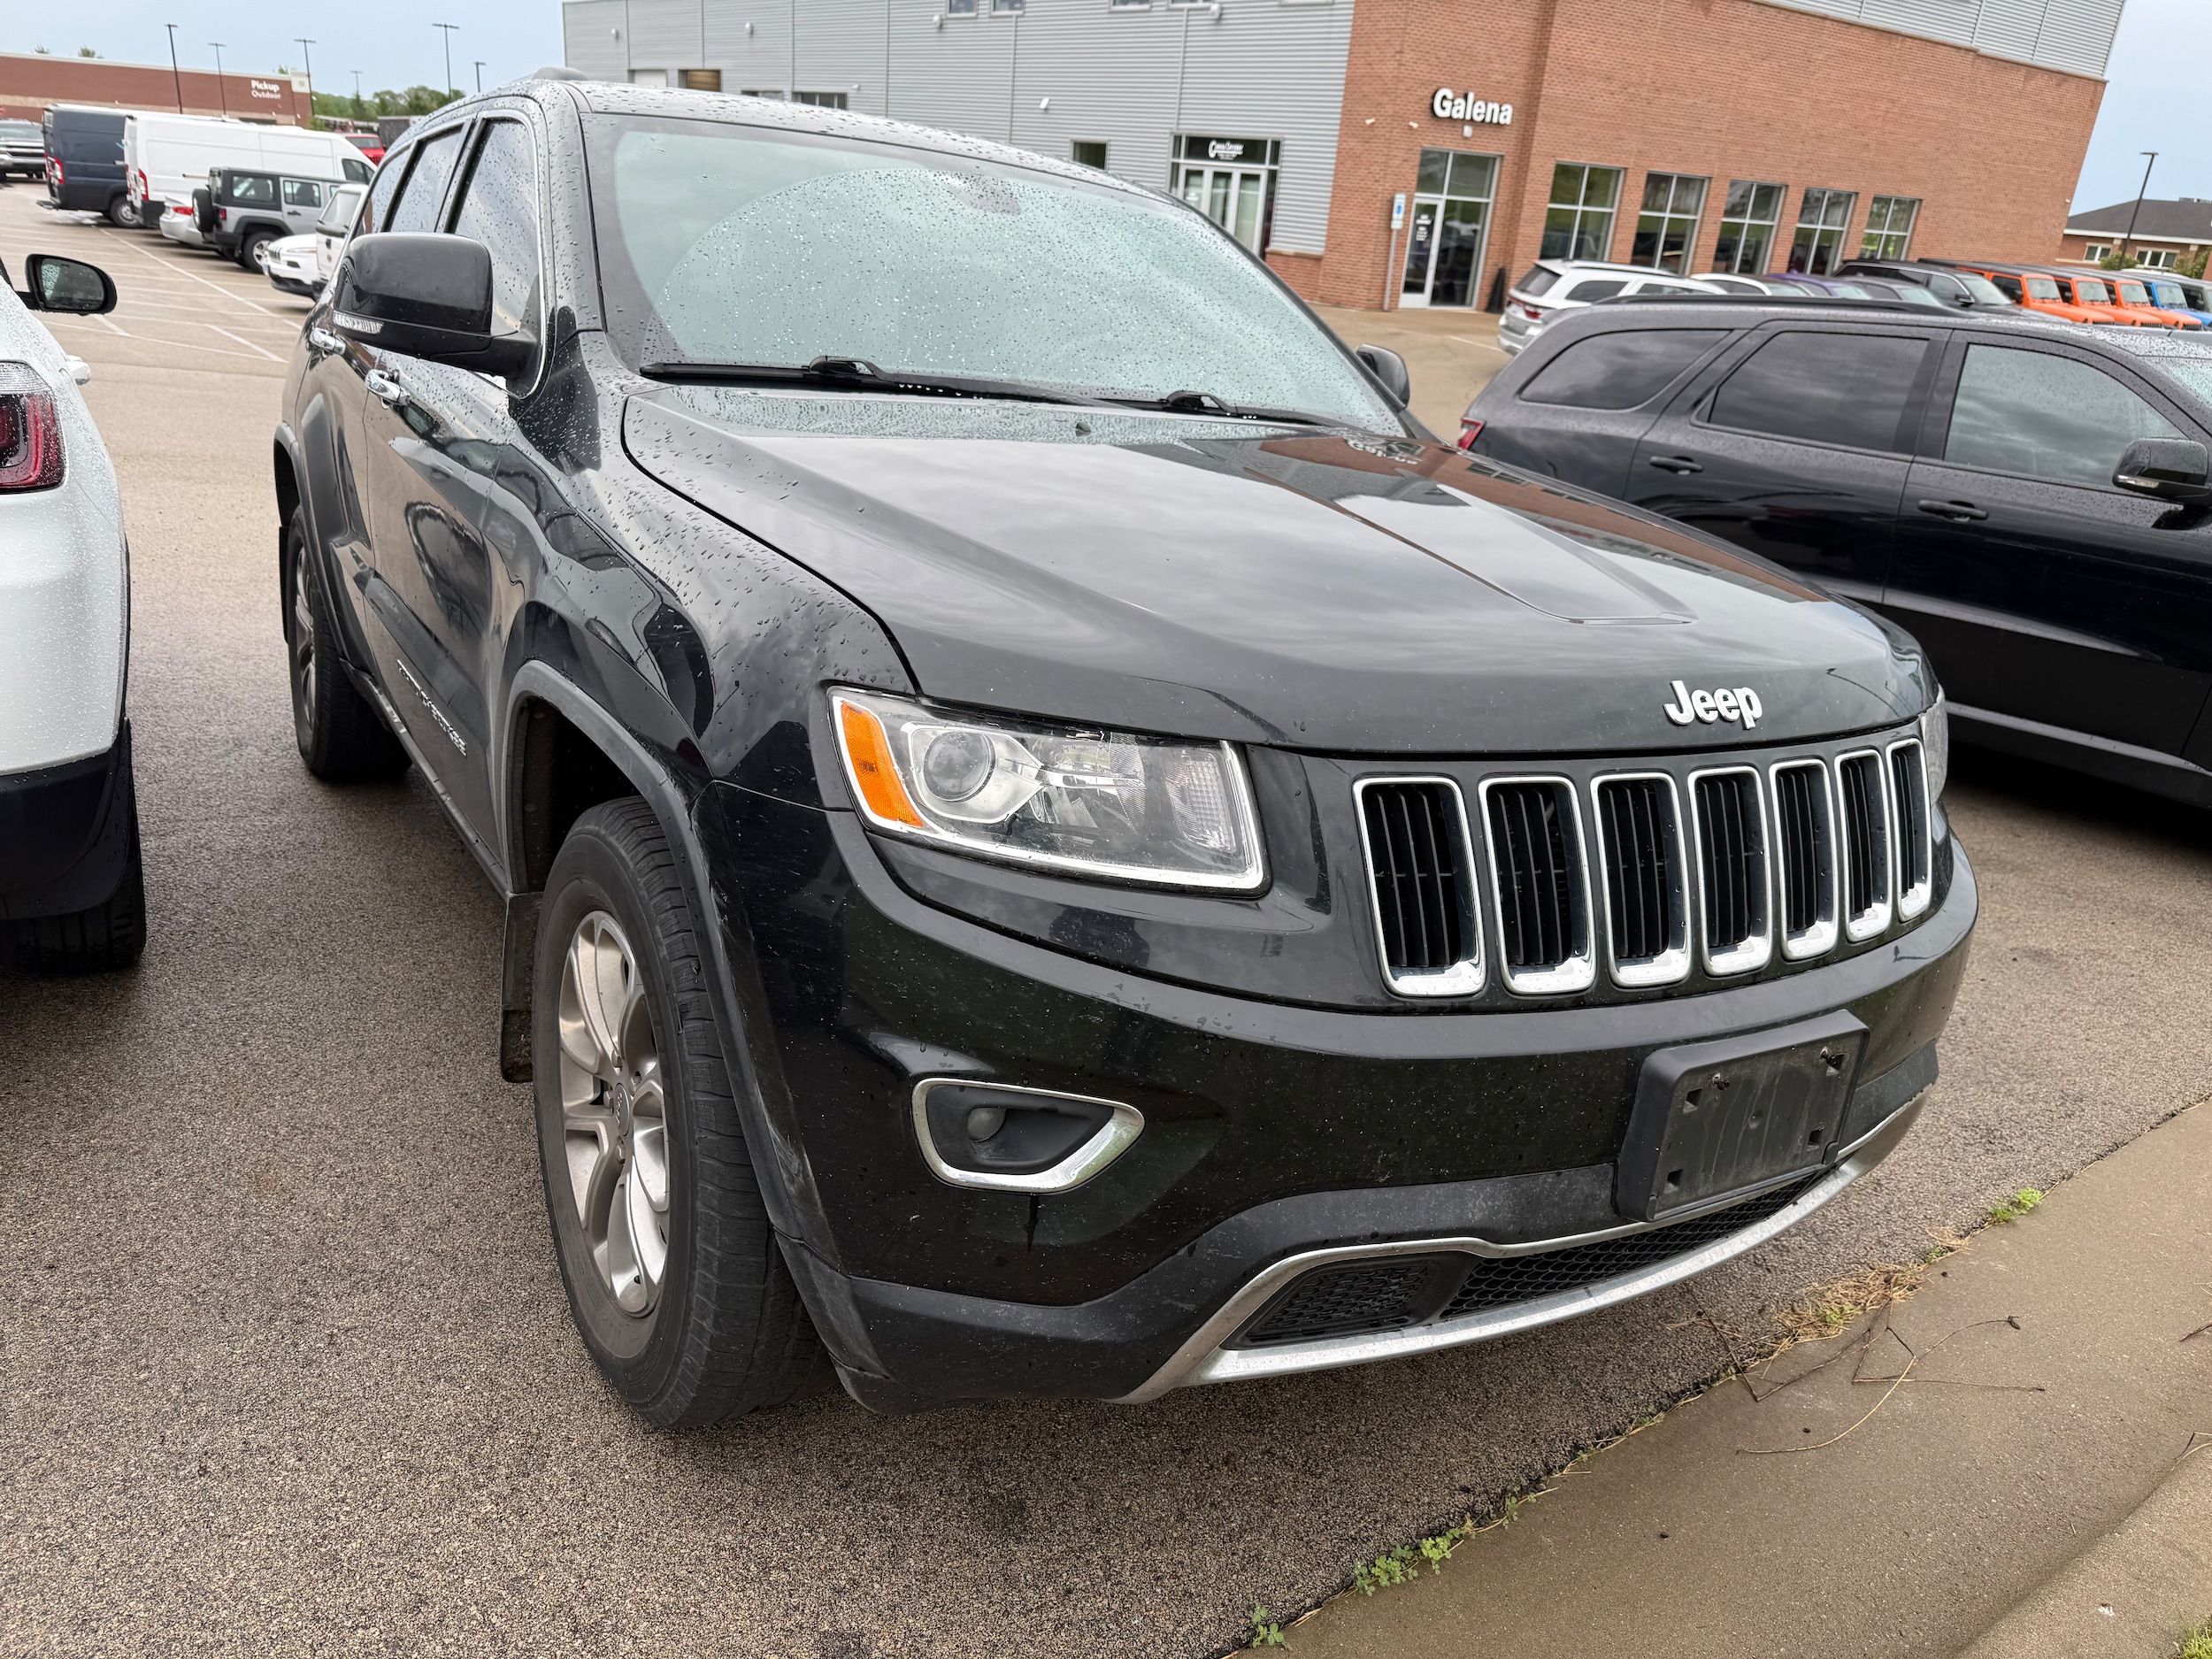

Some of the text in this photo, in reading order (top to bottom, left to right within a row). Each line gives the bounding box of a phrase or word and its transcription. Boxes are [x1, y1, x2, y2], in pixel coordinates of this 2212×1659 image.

[250, 79, 280, 93] Pickup
[1432, 88, 1513, 125] Galena
[1663, 680, 1763, 730] Jeep
